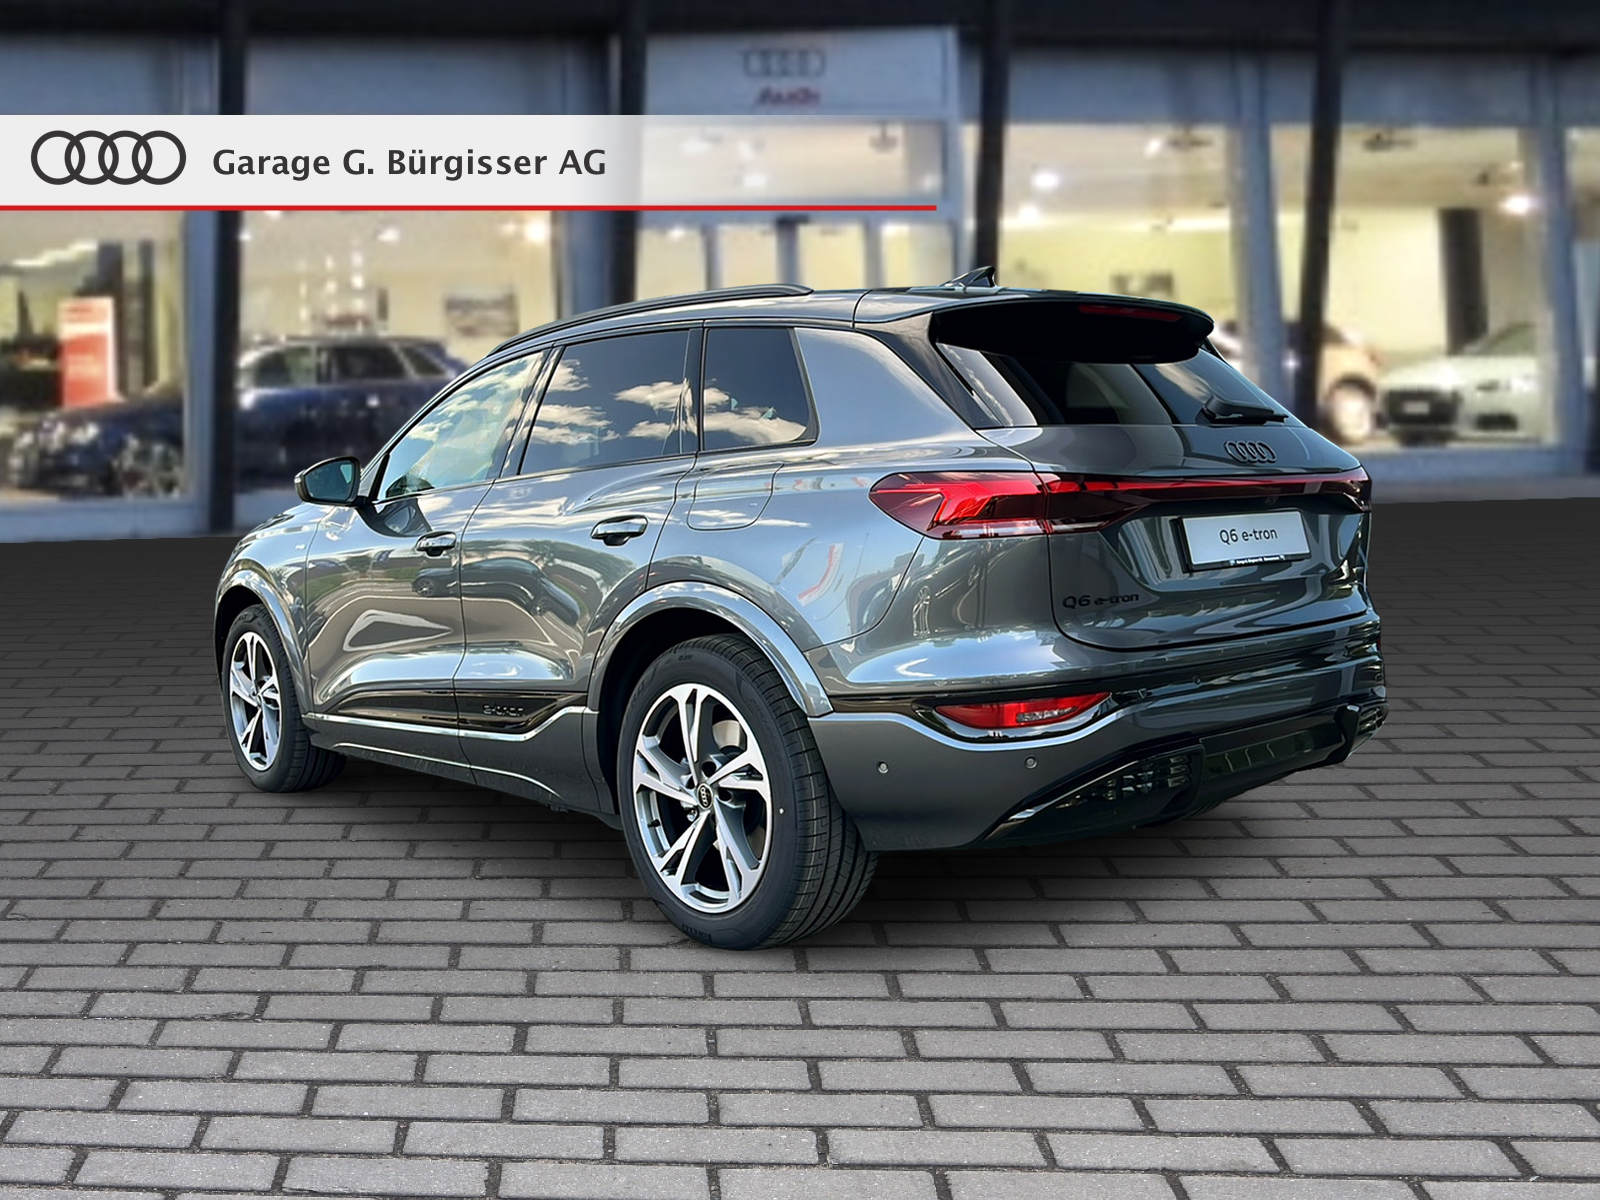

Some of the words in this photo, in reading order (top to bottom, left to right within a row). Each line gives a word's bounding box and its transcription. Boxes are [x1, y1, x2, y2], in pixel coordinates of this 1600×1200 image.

[1219, 528, 1239, 545] Q6
[1241, 528, 1278, 541] e-tron
[1062, 594, 1091, 609] Q6
[1094, 593, 1139, 605] e-tron
